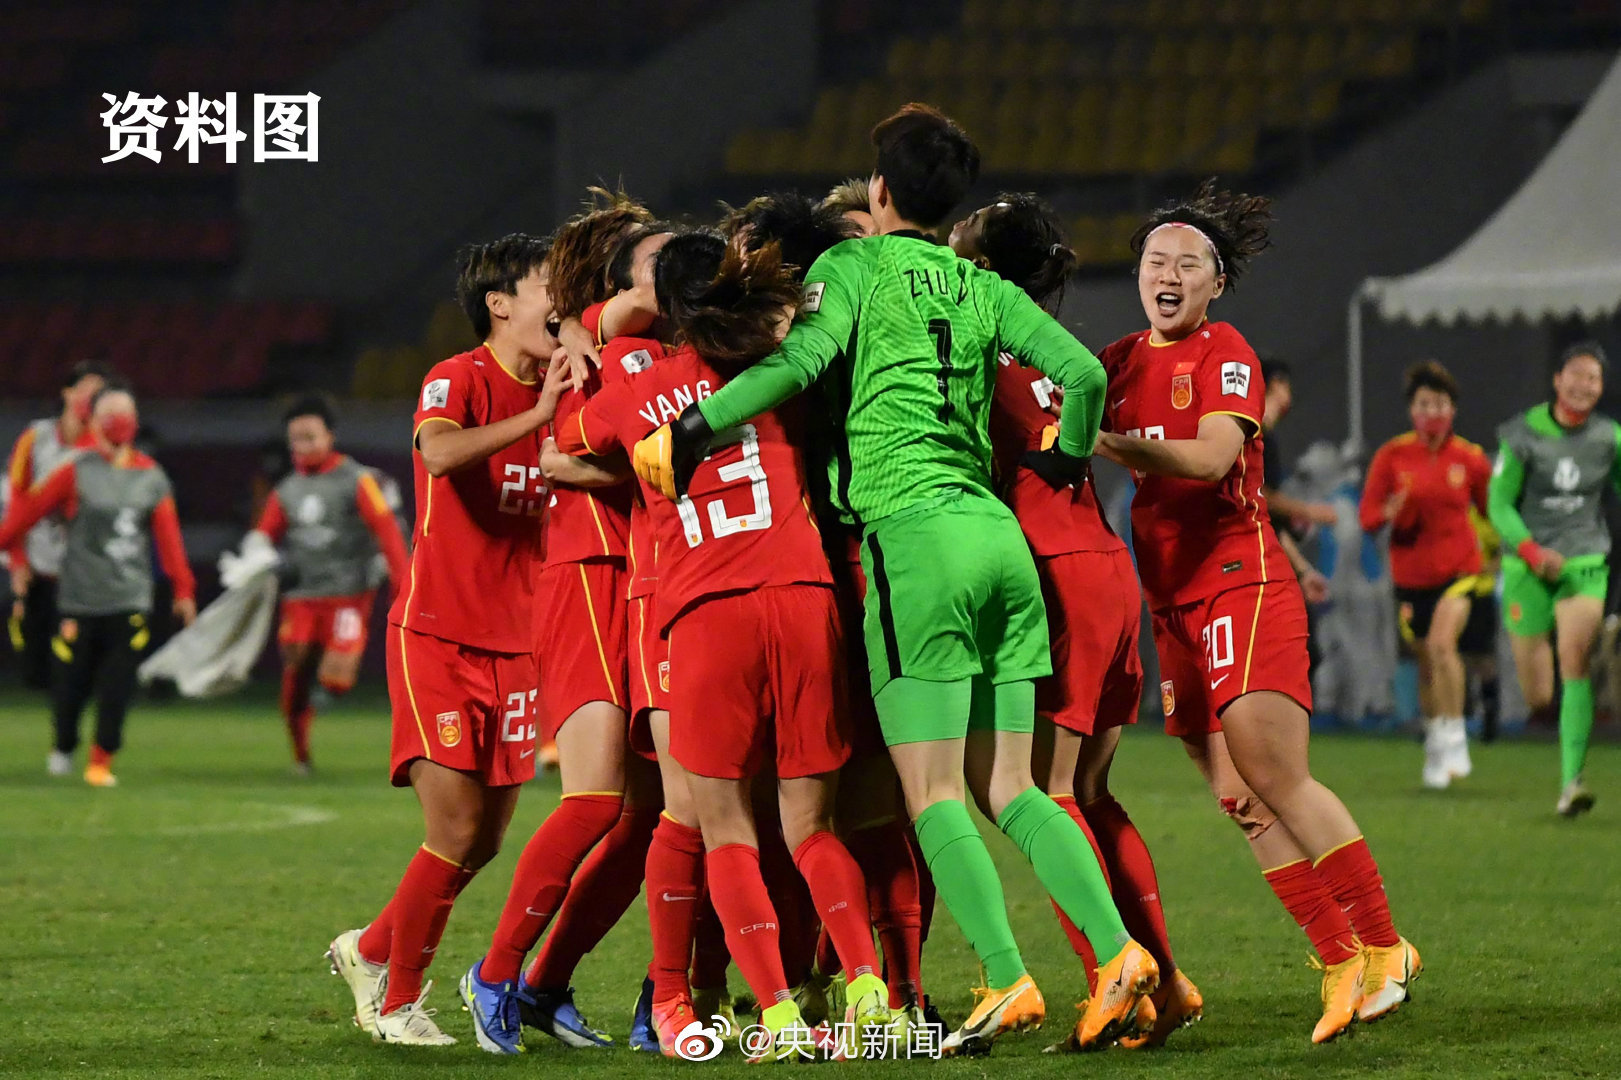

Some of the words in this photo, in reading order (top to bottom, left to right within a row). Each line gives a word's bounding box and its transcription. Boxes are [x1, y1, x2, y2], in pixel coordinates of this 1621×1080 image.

[903, 269, 948, 299] ZHU
[928, 319, 954, 425] 1
[638, 379, 712, 427] YANG
[740, 922, 776, 935] CFA
